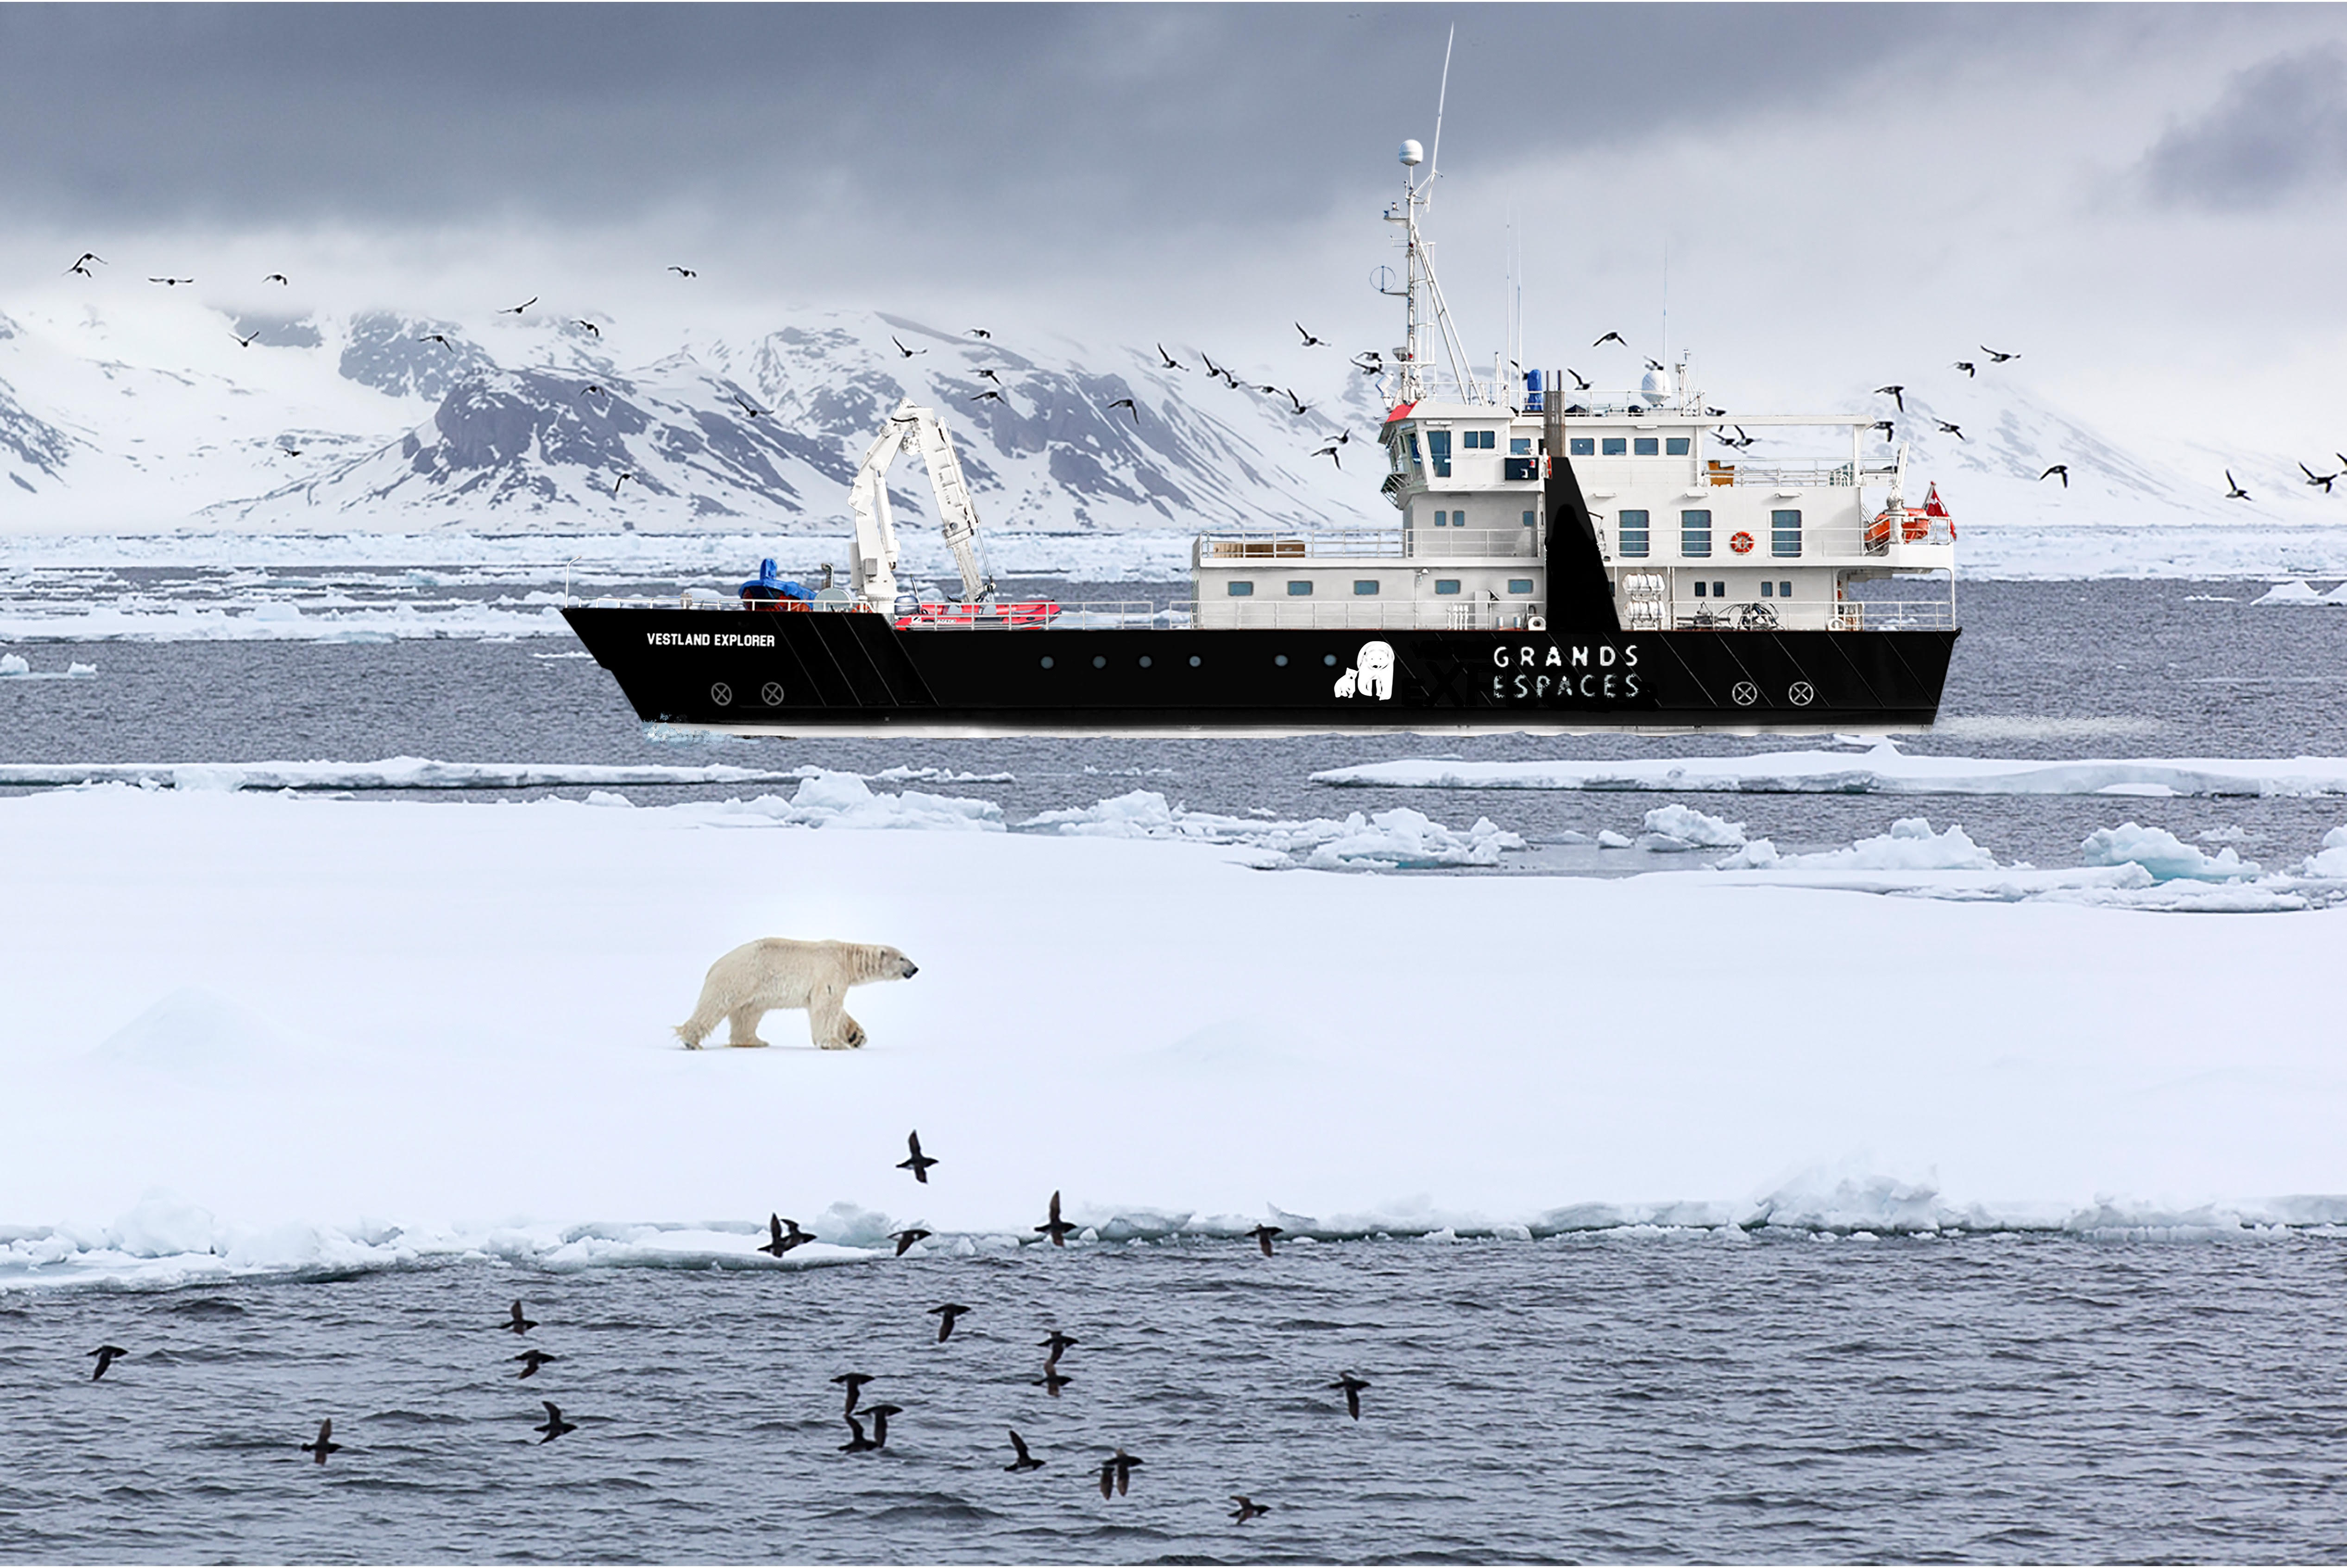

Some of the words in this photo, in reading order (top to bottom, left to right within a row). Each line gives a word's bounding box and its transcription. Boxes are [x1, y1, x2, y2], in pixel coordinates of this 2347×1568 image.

[647, 633, 710, 646] VESTLAND
[714, 634, 775, 647] EXPLORER
[1493, 645, 1638, 668] GRANDS
[1493, 674, 1639, 699] ESPACES
